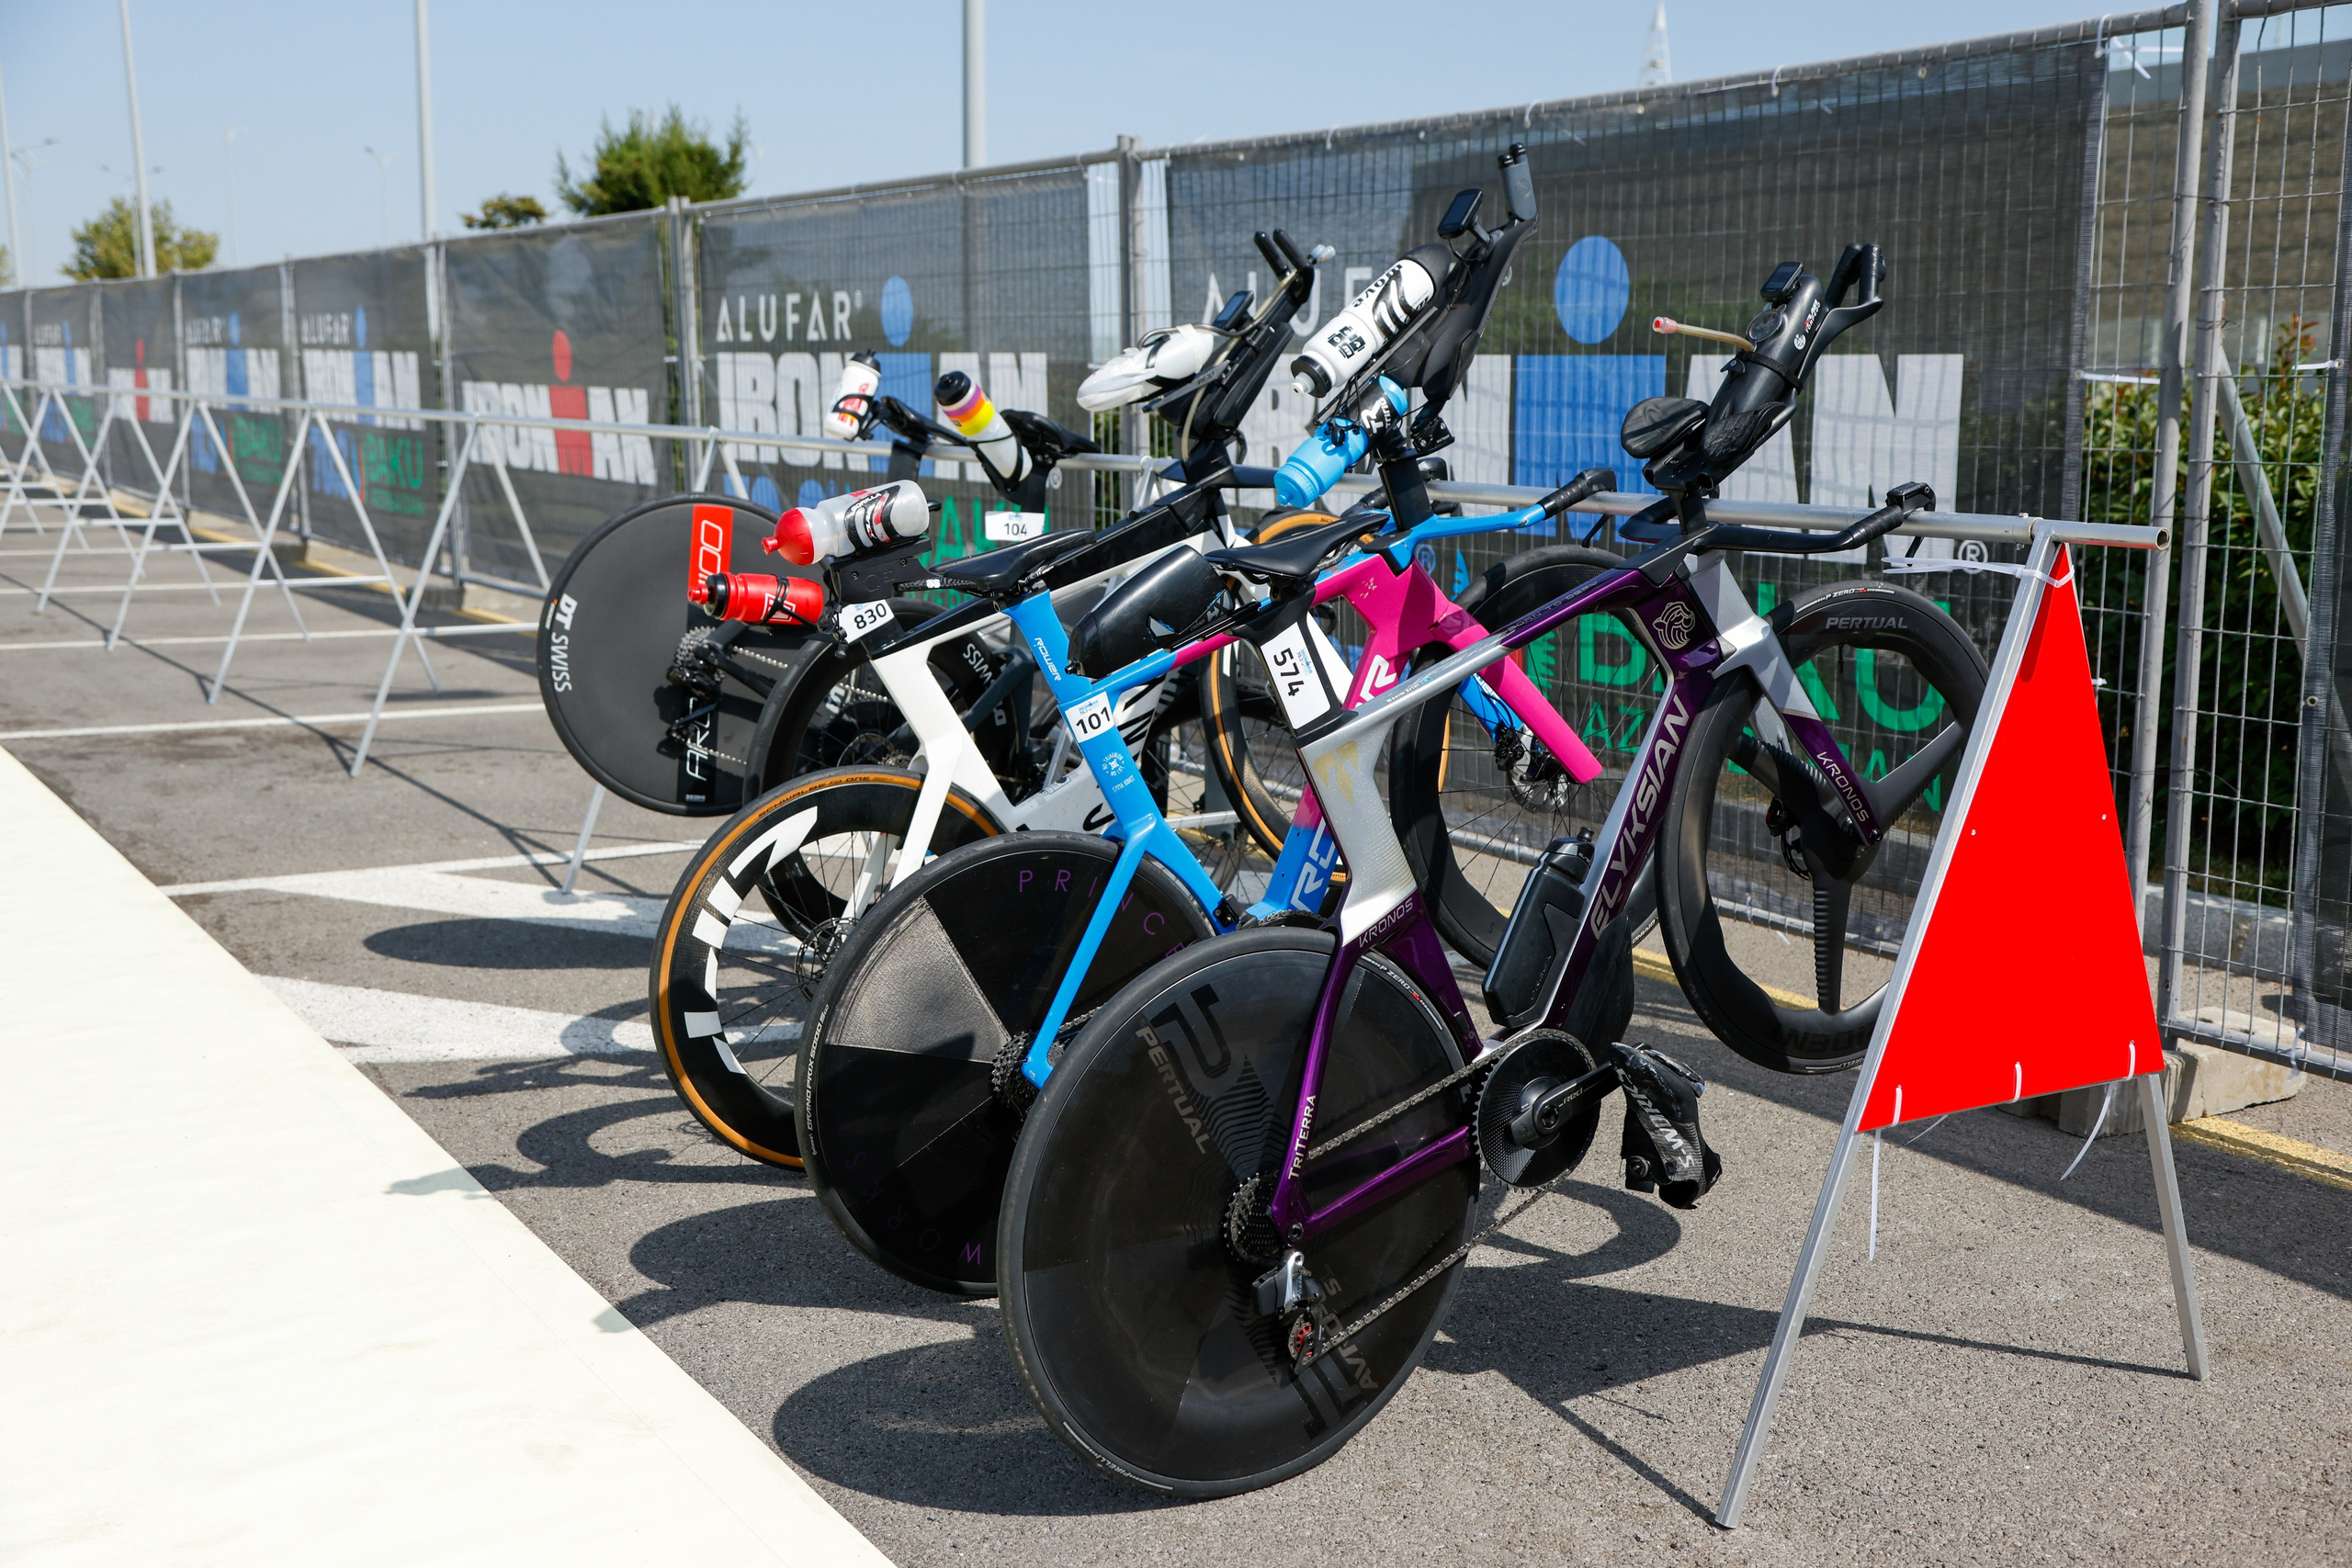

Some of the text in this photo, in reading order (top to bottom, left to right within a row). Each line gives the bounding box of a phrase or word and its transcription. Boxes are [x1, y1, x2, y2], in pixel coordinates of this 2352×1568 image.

[1004, 523, 1028, 536] 104
[555, 592, 579, 631] DT
[854, 603, 888, 630] 830
[1825, 616, 1908, 629] PERTUAL
[550, 632, 572, 693] SWISS
[1034, 637, 1062, 682] ROWER
[1272, 647, 1305, 697] 574
[1075, 705, 1111, 735] 101
[758, 783, 827, 818] SCHWALBE
[1815, 750, 1871, 823] KRONOS
[1590, 694, 1692, 941] ELYKSIAN
[1358, 897, 1414, 949] KRONOS
[1386, 969, 1411, 990] ZERO
[806, 1059, 817, 1089] PRIX
[1134, 1024, 1212, 1156] PERTUAL
[1095, 1454, 1131, 1477] PIRELLI
